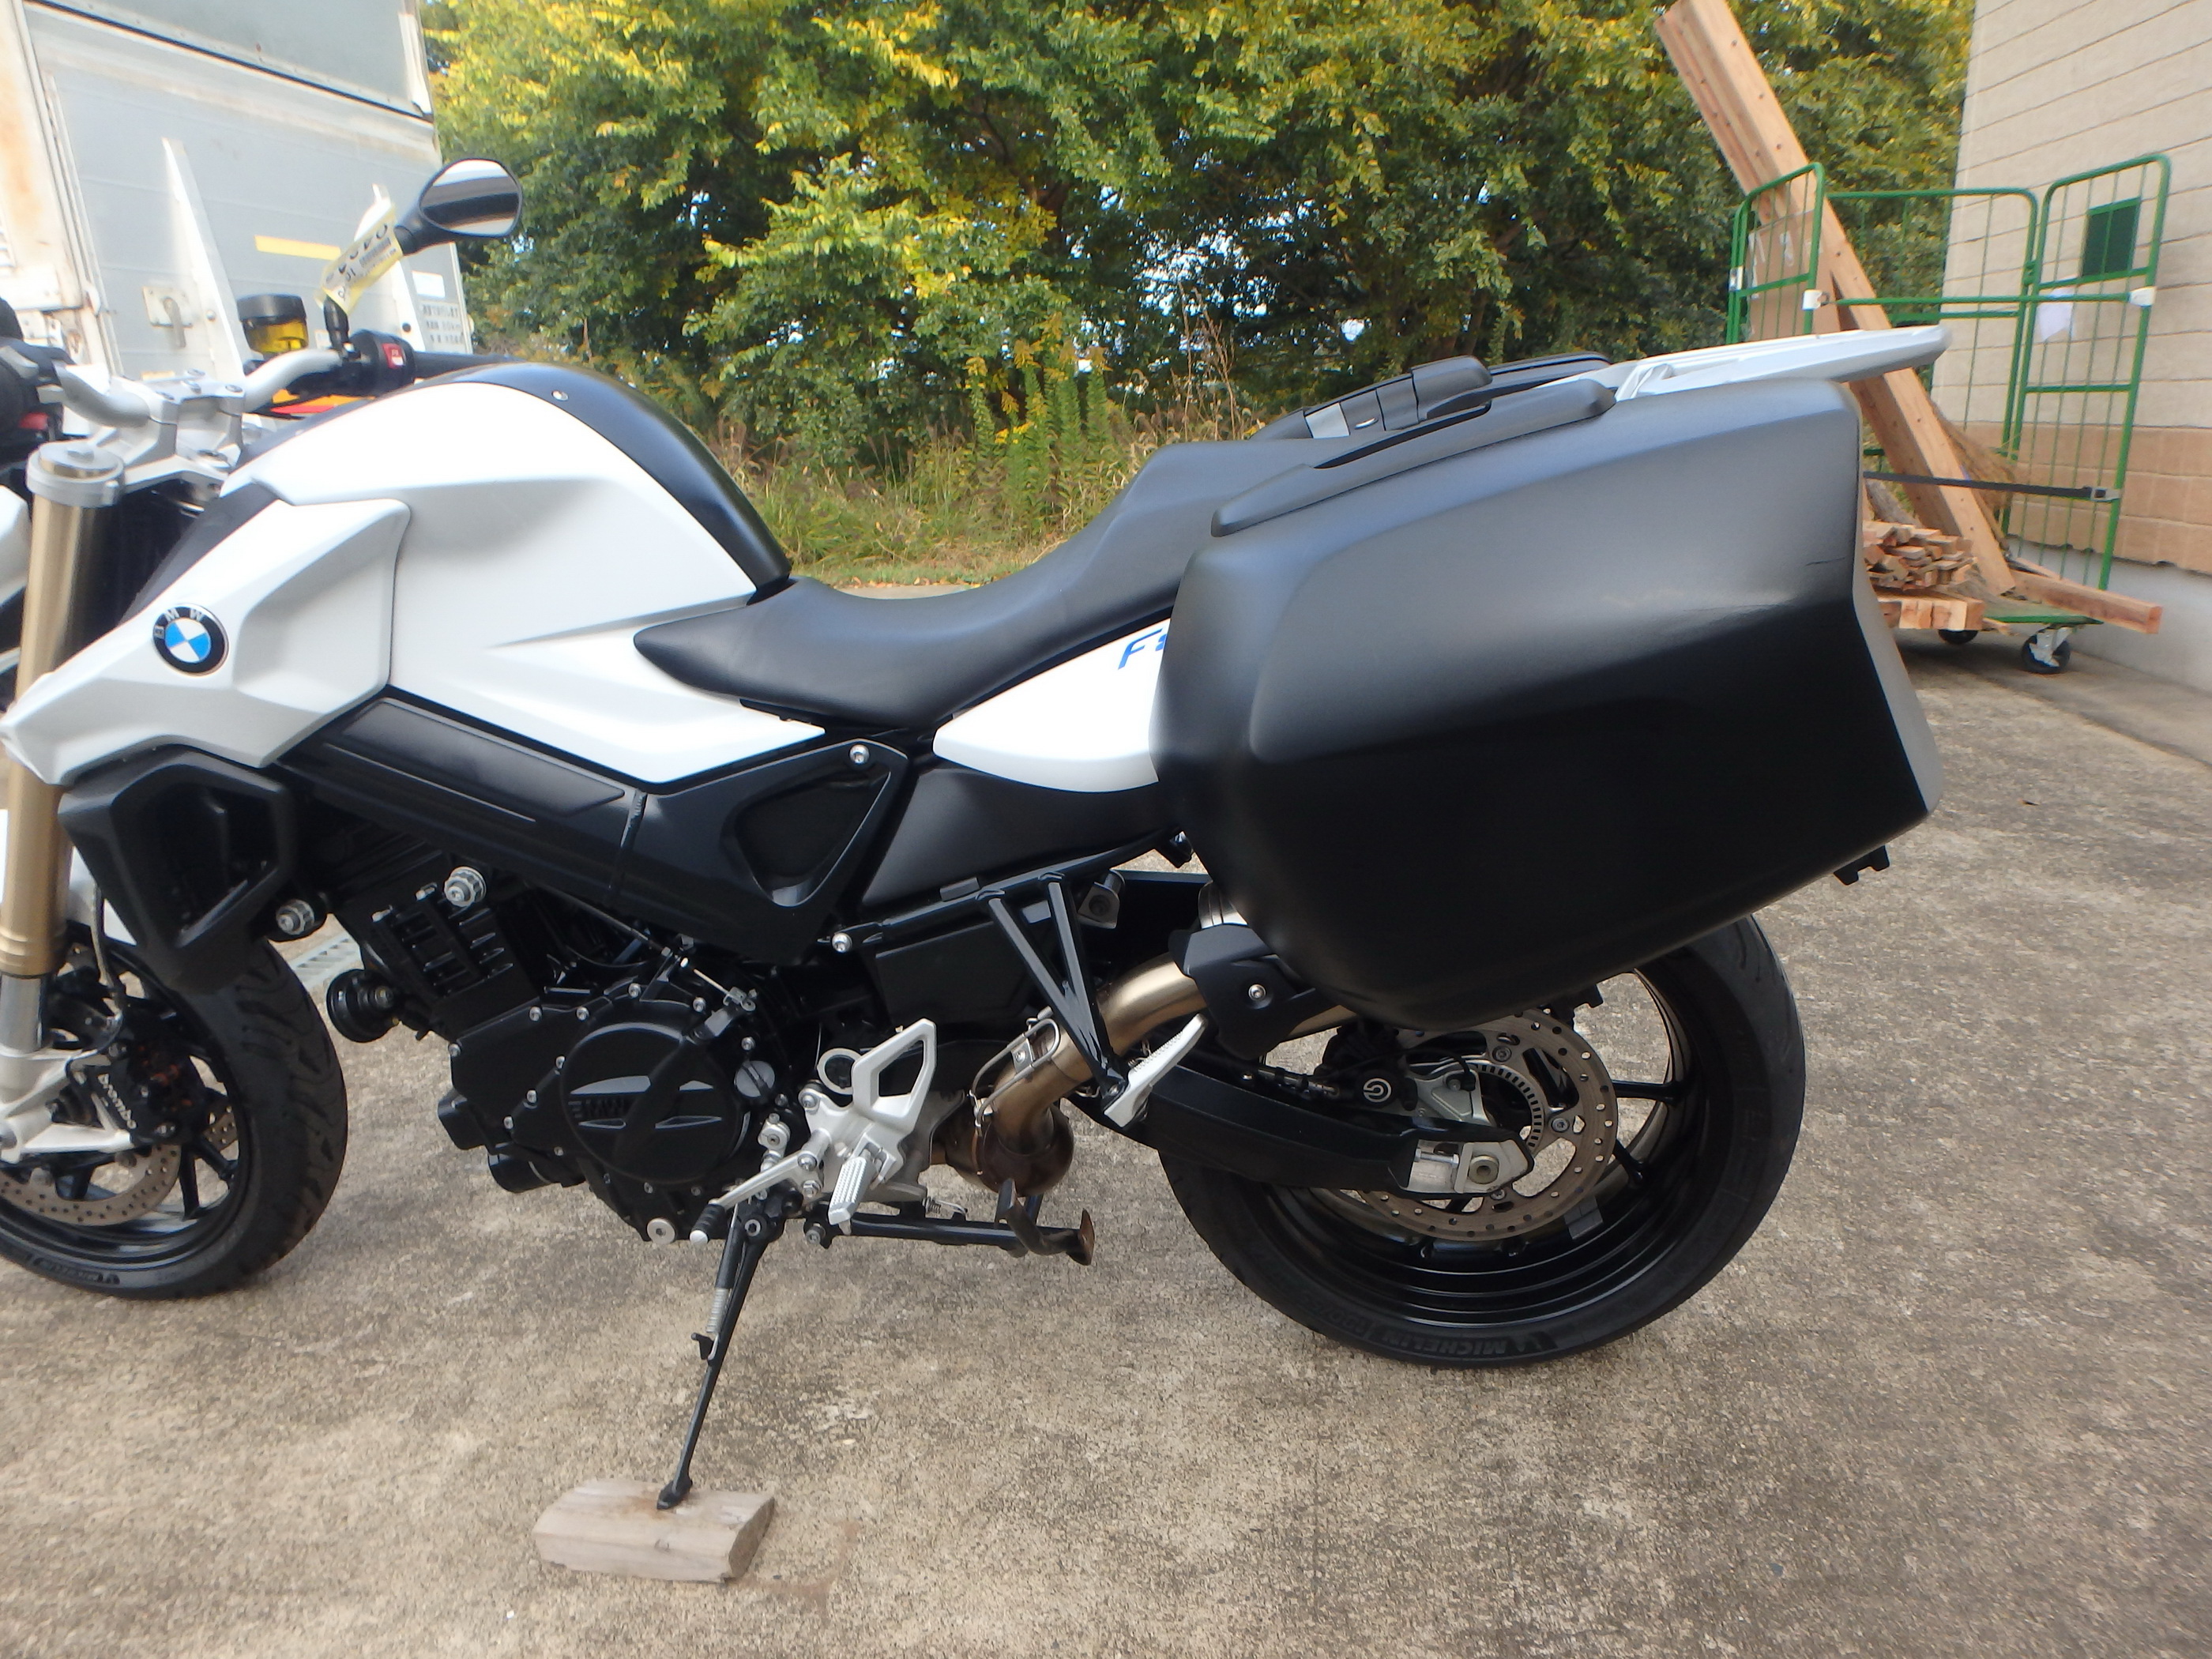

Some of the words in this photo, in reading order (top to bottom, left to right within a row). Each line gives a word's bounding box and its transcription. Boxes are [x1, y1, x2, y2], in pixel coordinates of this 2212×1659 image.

[153, 608, 205, 638] BMW
[97, 1073, 137, 1130] brembo
[1381, 1330, 1507, 1355] MICHELIN
